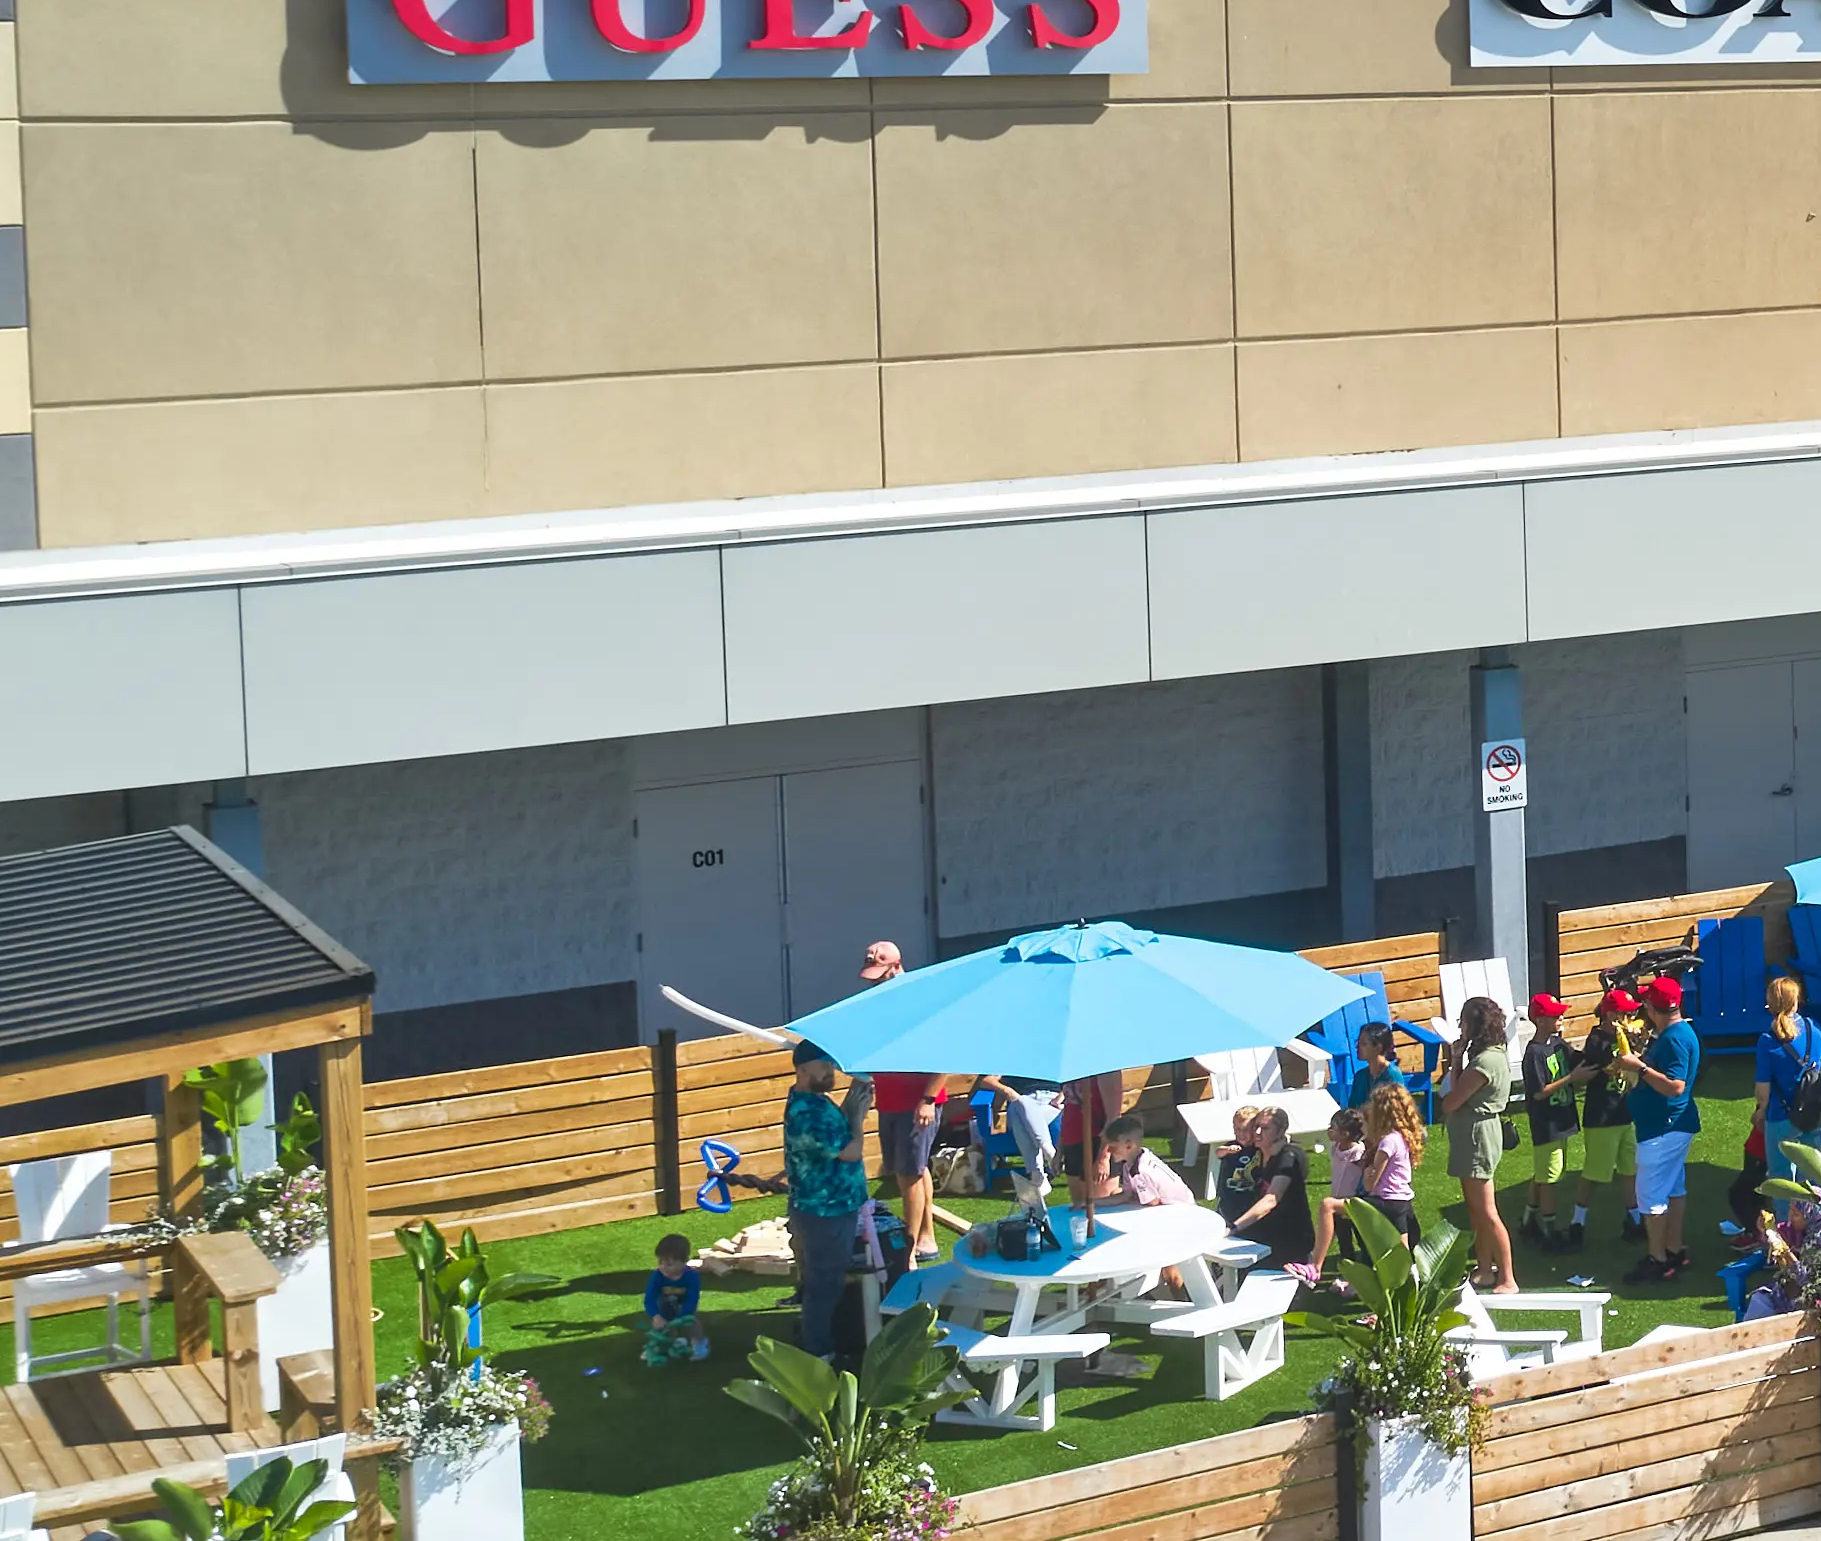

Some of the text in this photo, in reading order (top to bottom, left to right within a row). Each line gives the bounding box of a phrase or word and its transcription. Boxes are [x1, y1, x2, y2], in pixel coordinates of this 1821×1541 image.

[1499, 785, 1511, 793] NO
[1487, 792, 1523, 804] SMOKING
[692, 848, 724, 868] C01
